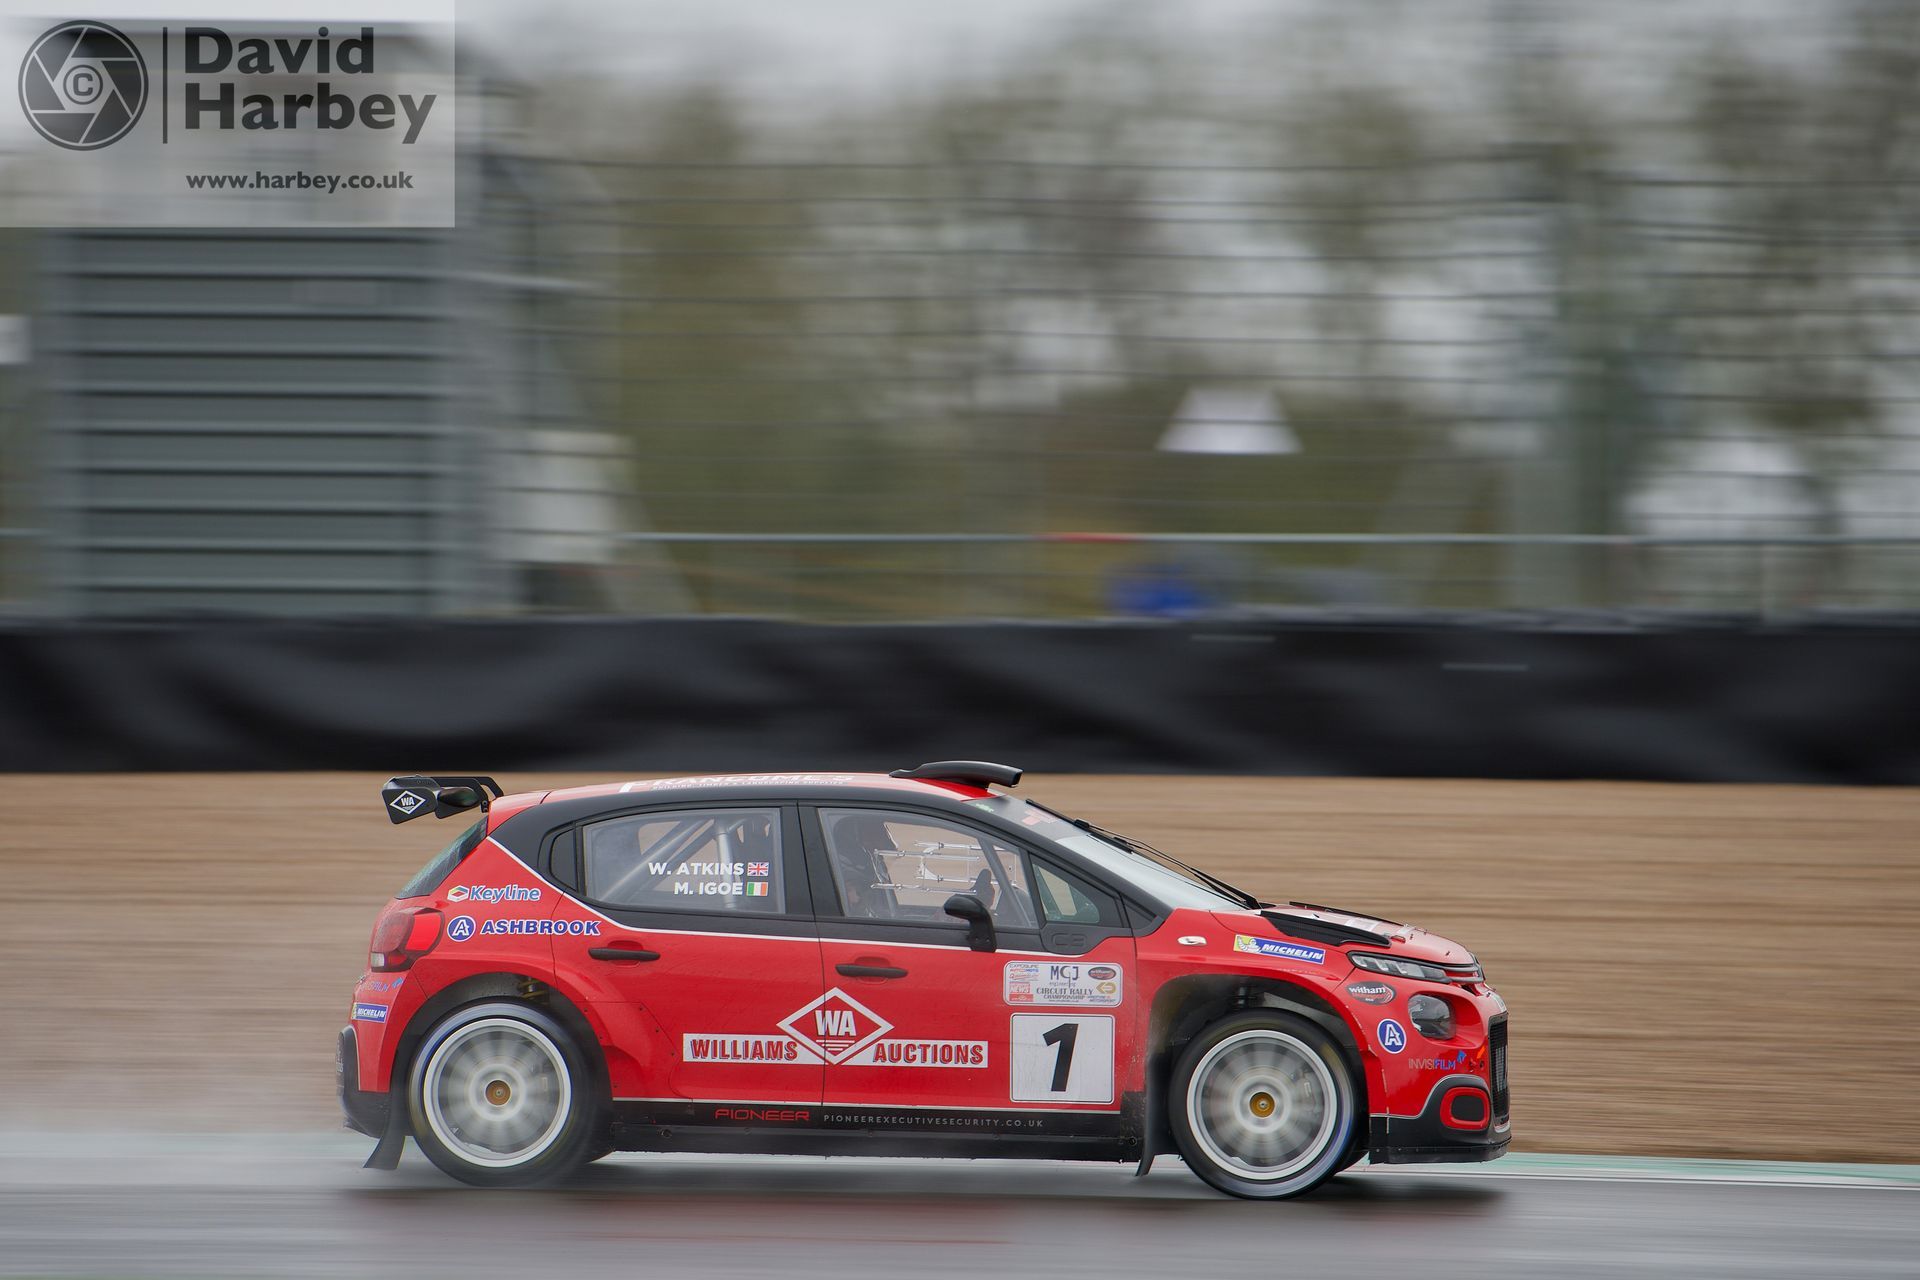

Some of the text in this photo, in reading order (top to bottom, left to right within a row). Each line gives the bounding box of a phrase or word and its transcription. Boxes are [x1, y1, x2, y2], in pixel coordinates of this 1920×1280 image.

[401, 797, 415, 807] WA
[648, 862, 745, 876] W. ATKINS
[470, 884, 542, 903] Keyline
[674, 882, 743, 895] M. IGOE
[480, 919, 601, 936] ASHBROOK
[1261, 943, 1323, 960] MICHELIN
[1036, 987, 1094, 996] CIRCUIT RALLY
[1348, 986, 1386, 994] witham
[357, 1008, 386, 1018] MICHELIN
[814, 1010, 857, 1036] WA
[690, 1039, 985, 1065] WILLIAMS AUCTIONS
[1042, 1023, 1079, 1092] 1
[1408, 1058, 1457, 1071] INVISIFILM
[715, 1109, 1044, 1127] PIONEER PIONEEREXECUTIVESECURITY.CO.UK
